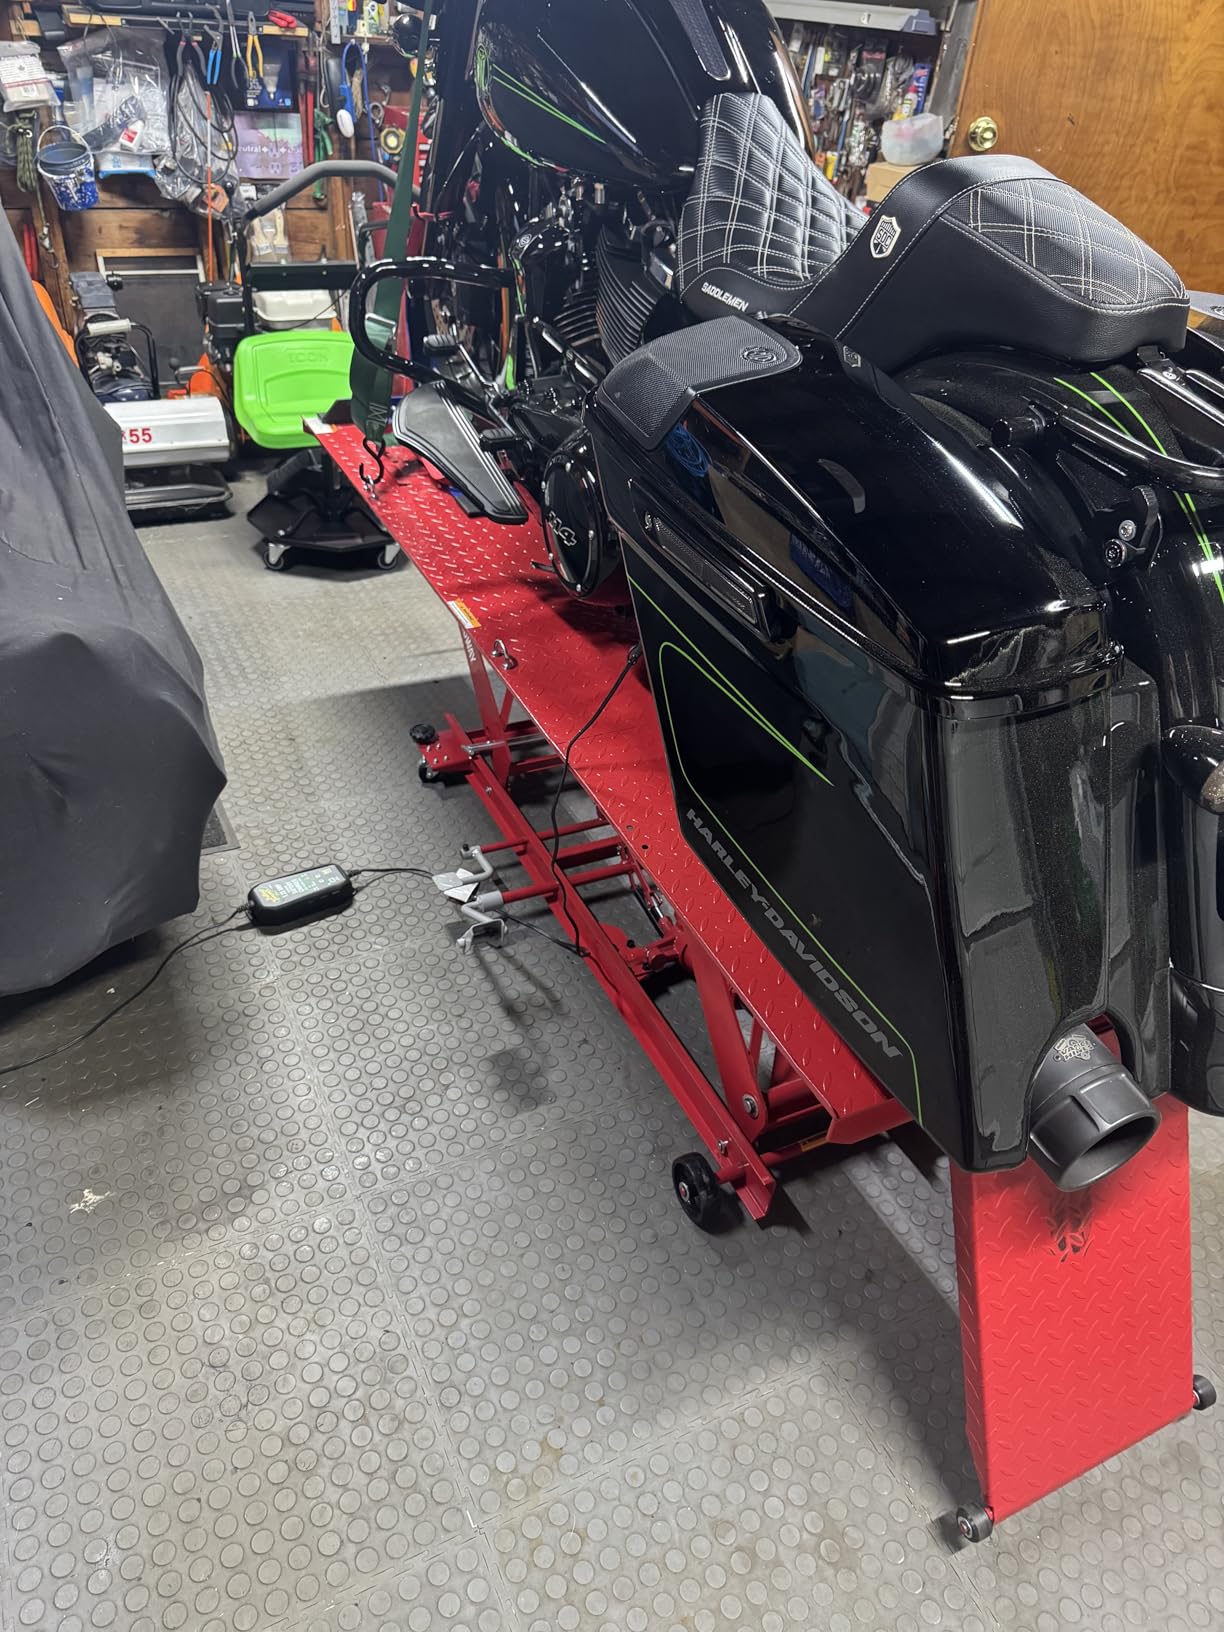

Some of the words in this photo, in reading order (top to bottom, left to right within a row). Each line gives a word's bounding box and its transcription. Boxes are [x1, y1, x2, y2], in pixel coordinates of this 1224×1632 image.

[701, 282, 749, 312] SADDLEMEN
[129, 428, 153, 444] 55
[686, 808, 903, 1059] HARLEY-DAVIDSON
